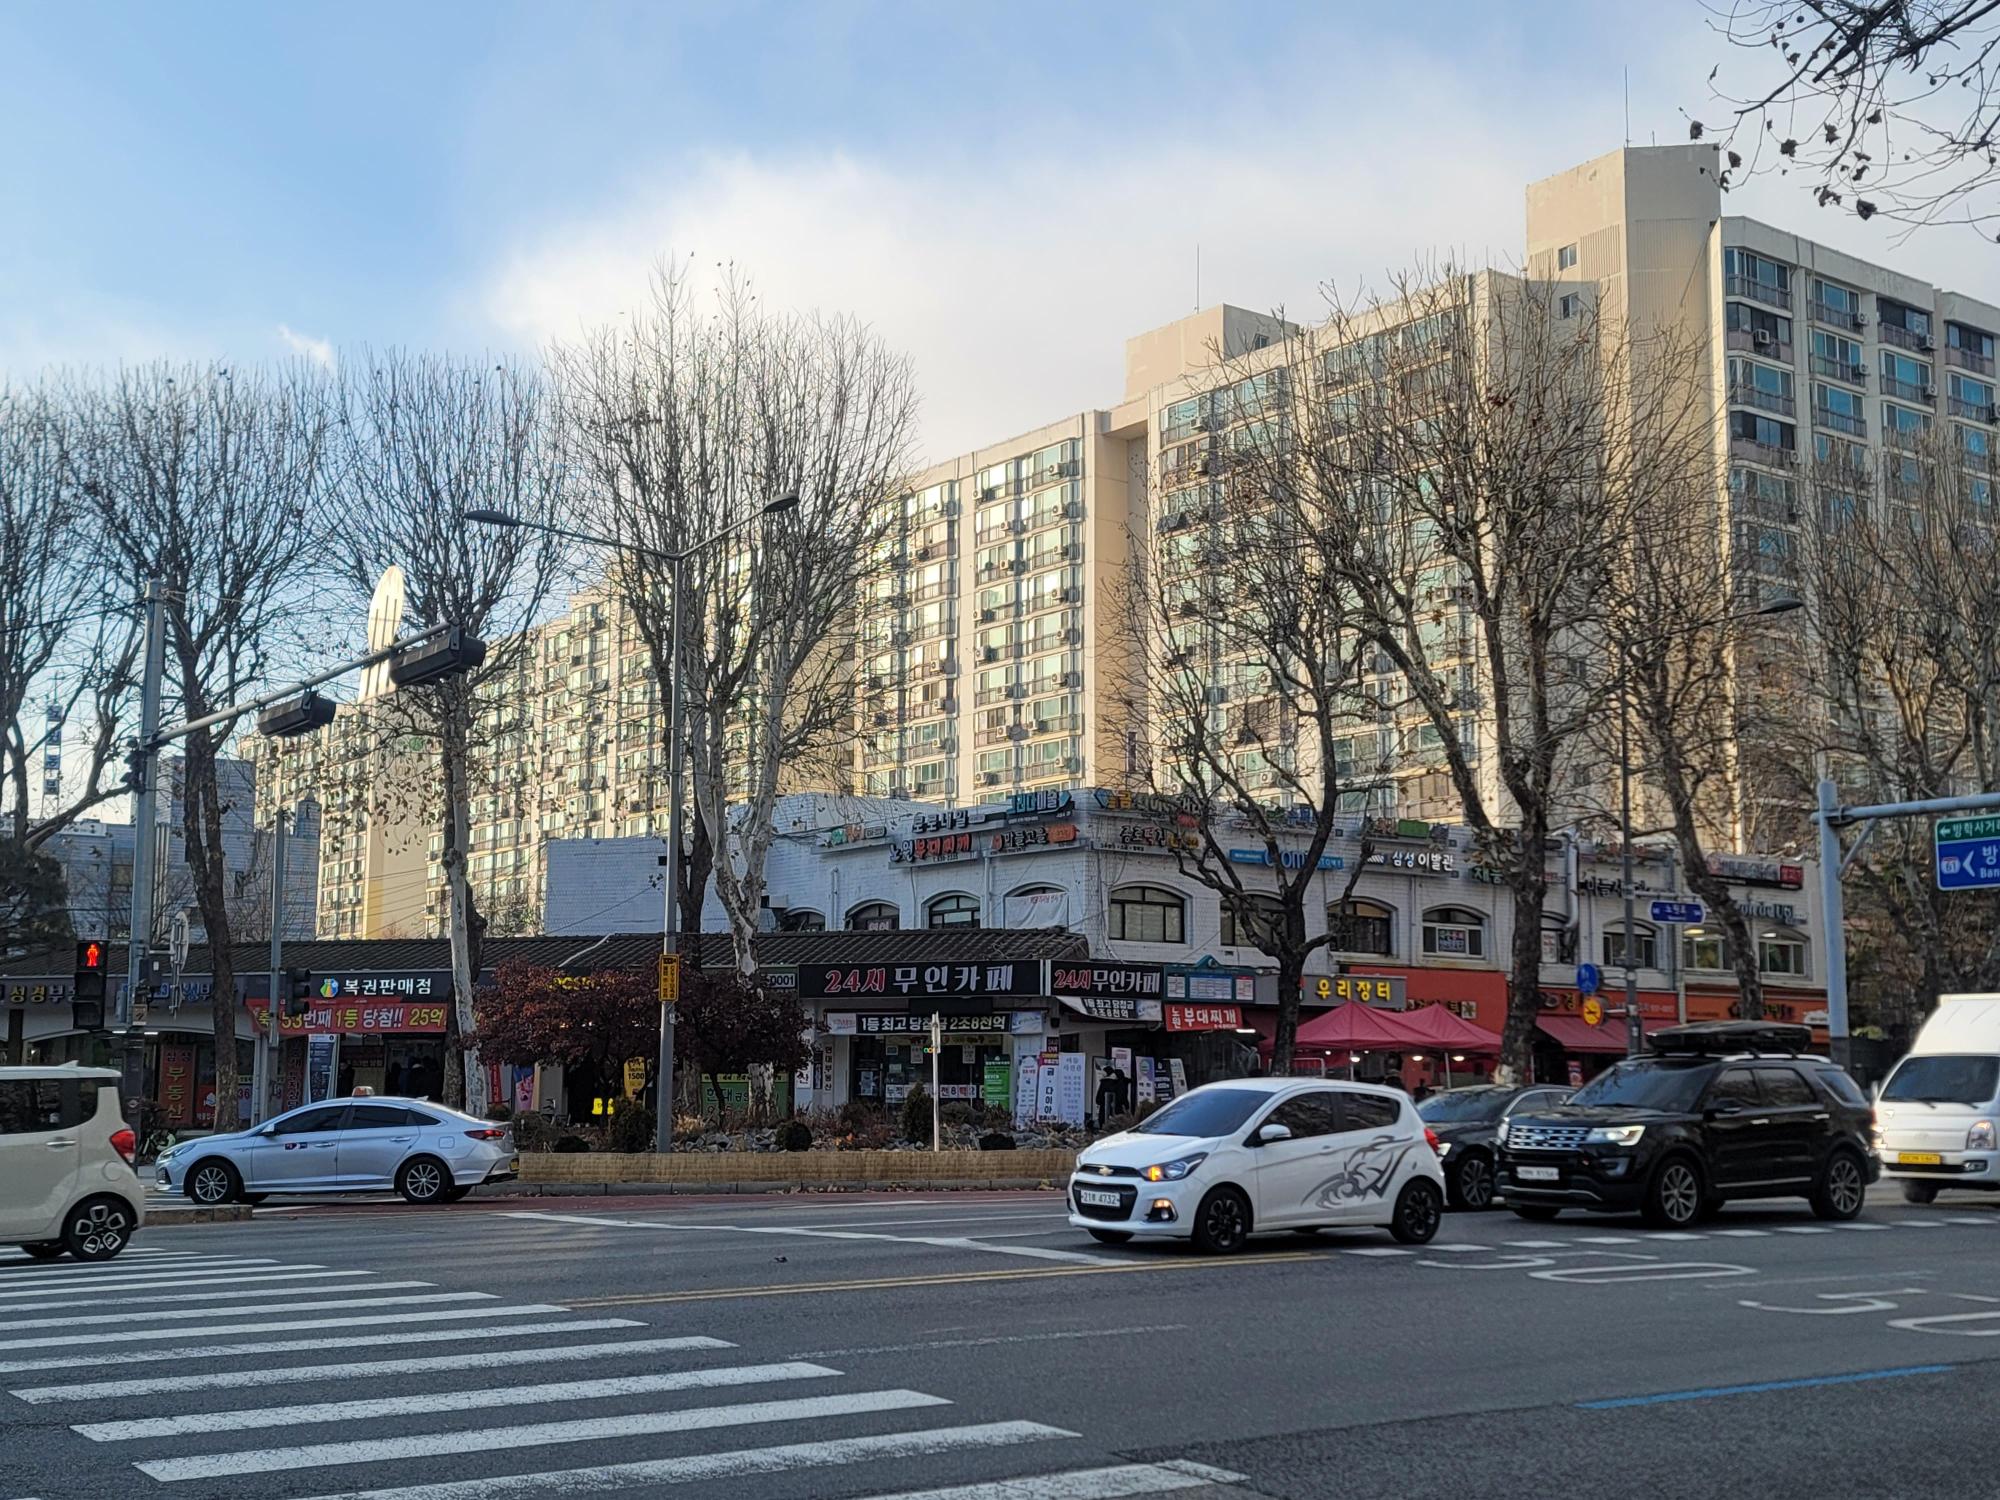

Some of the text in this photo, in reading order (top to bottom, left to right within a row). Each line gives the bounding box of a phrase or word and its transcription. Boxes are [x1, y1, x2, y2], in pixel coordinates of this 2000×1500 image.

[1391, 851, 1454, 871] 삼성 이발관
[343, 978, 432, 995] 복권판매점
[825, 964, 1014, 994] 24시 무인카페
[1054, 969, 1161, 994] 24시 무인카페
[1317, 979, 1391, 1001] 우리장터
[336, 1009, 358, 1029] 1등
[362, 1009, 403, 1029] 당첨!!
[862, 1018, 879, 1031] 1등
[882, 1017, 907, 1031] 최고
[950, 1015, 1006, 1031] 2조8천억
[1184, 1007, 1237, 1026] 부대찌개
[166, 1066, 187, 1120] 부동산
